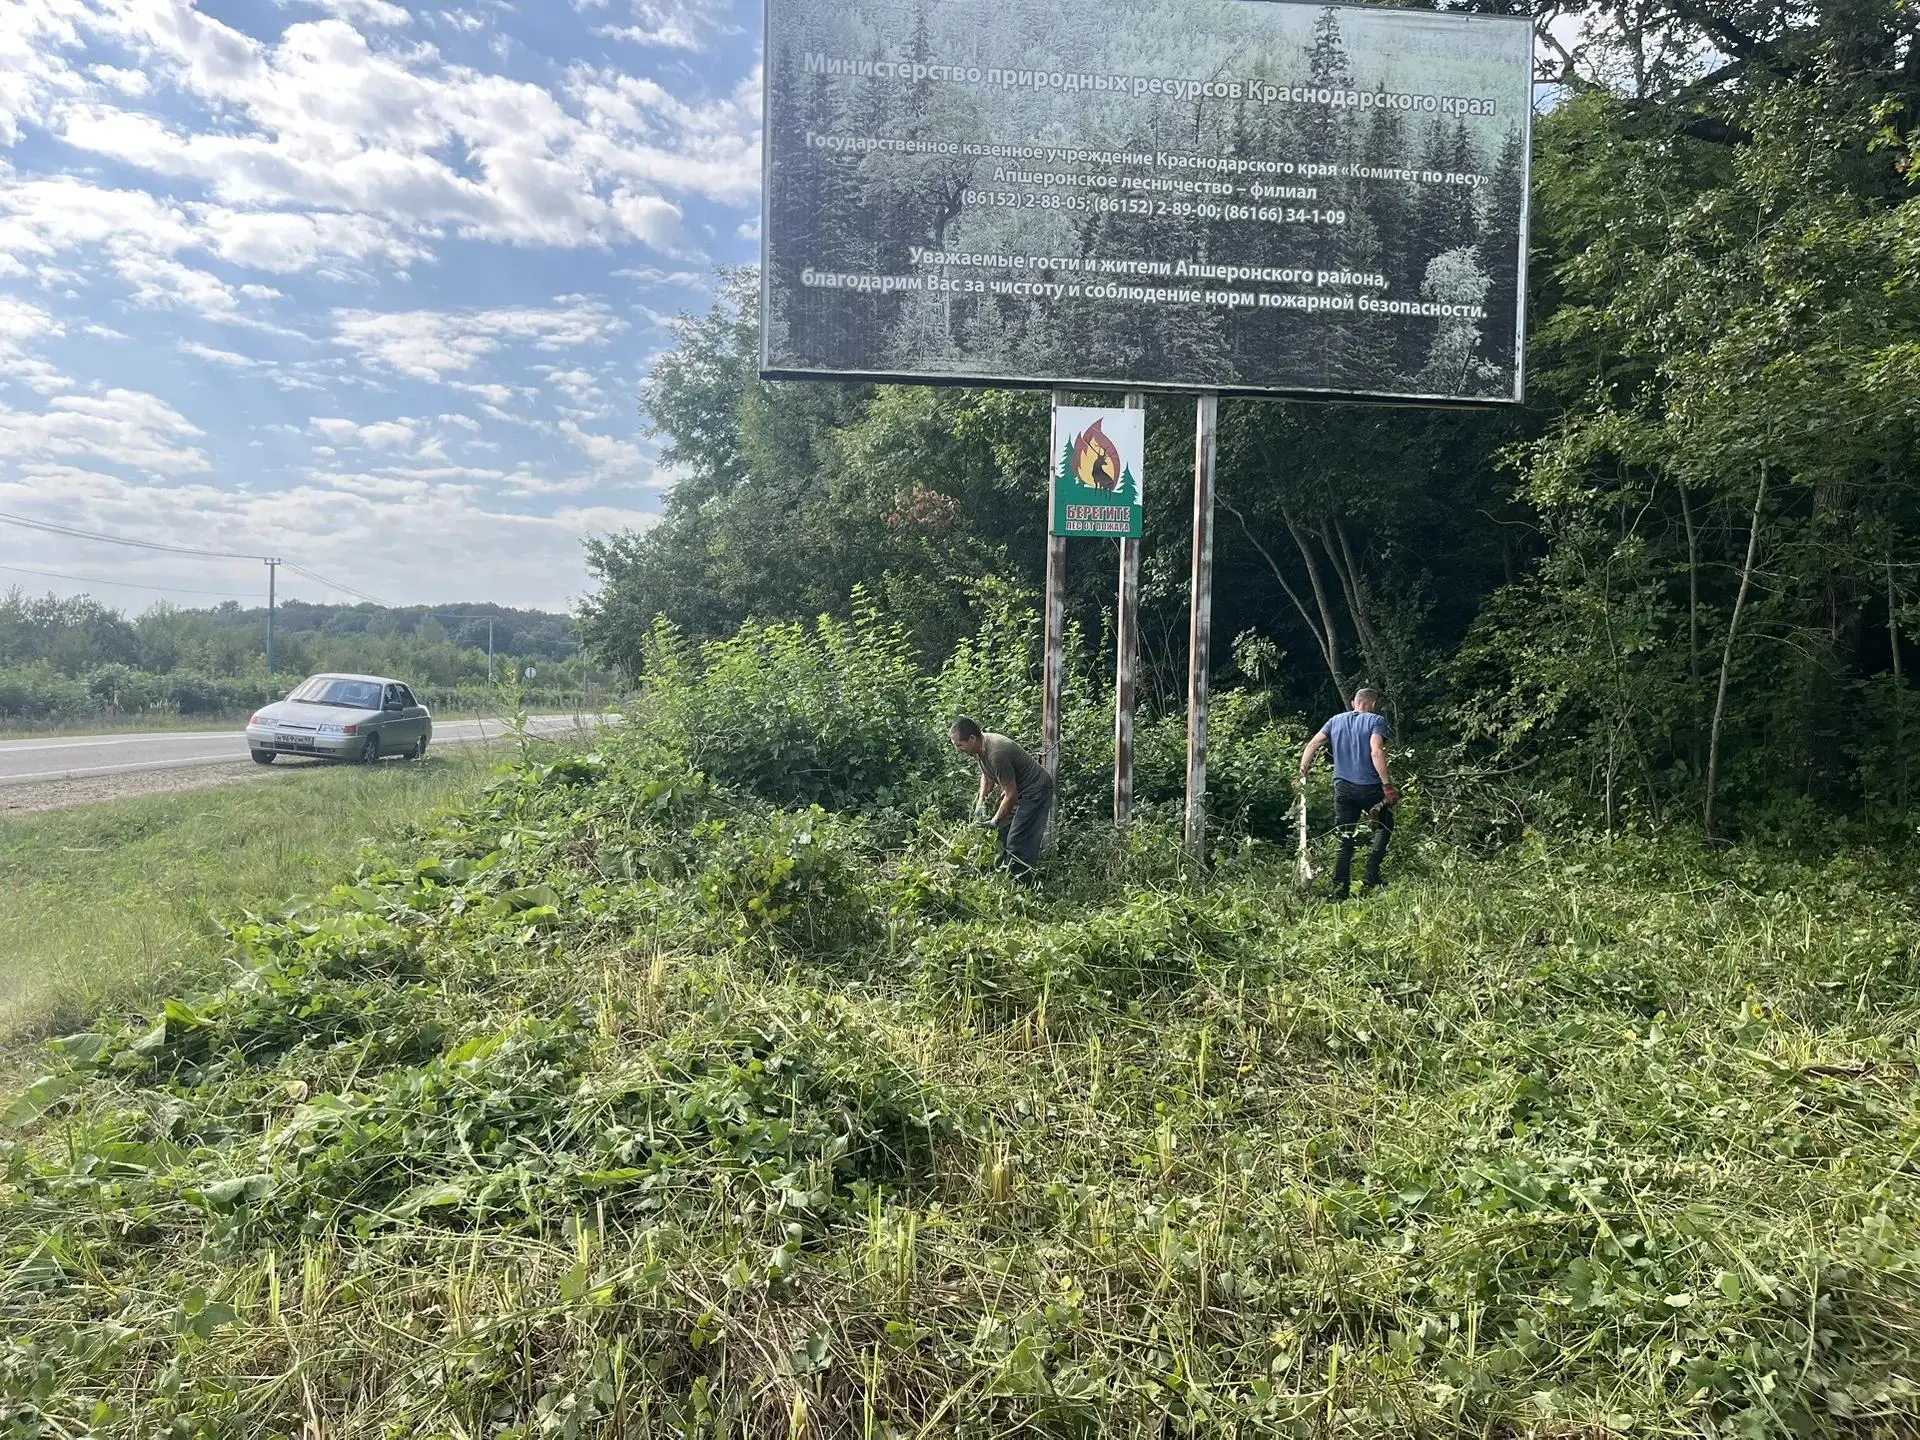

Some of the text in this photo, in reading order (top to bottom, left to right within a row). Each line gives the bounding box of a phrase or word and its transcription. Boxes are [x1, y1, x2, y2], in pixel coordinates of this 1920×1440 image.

[804, 52, 1496, 117] Министерство природных ресурсов Краснодарского края
[805, 132, 1490, 189] Государственное казенное учреждение Краснодарского края «Комитет по лесу»
[993, 167, 1118, 190] Апшеронское
[1121, 177, 1233, 195] лесничество
[1250, 180, 1318, 201] филиал
[961, 189, 1347, 225] (86152) 2-88-05; (86152) 2-89-00; (86166) 34-1-09
[909, 246, 1391, 290] Уважаемые гости и жители Апшеронского района,
[801, 268, 1488, 319] благодарим Вас за чистоту и соблюдение норм пожарной безопасности.
[1066, 504, 1131, 521] БЕРЕГИТЕ
[1083, 521, 1095, 531] ОТ
[1095, 522, 1131, 532] ПОЖАРА
